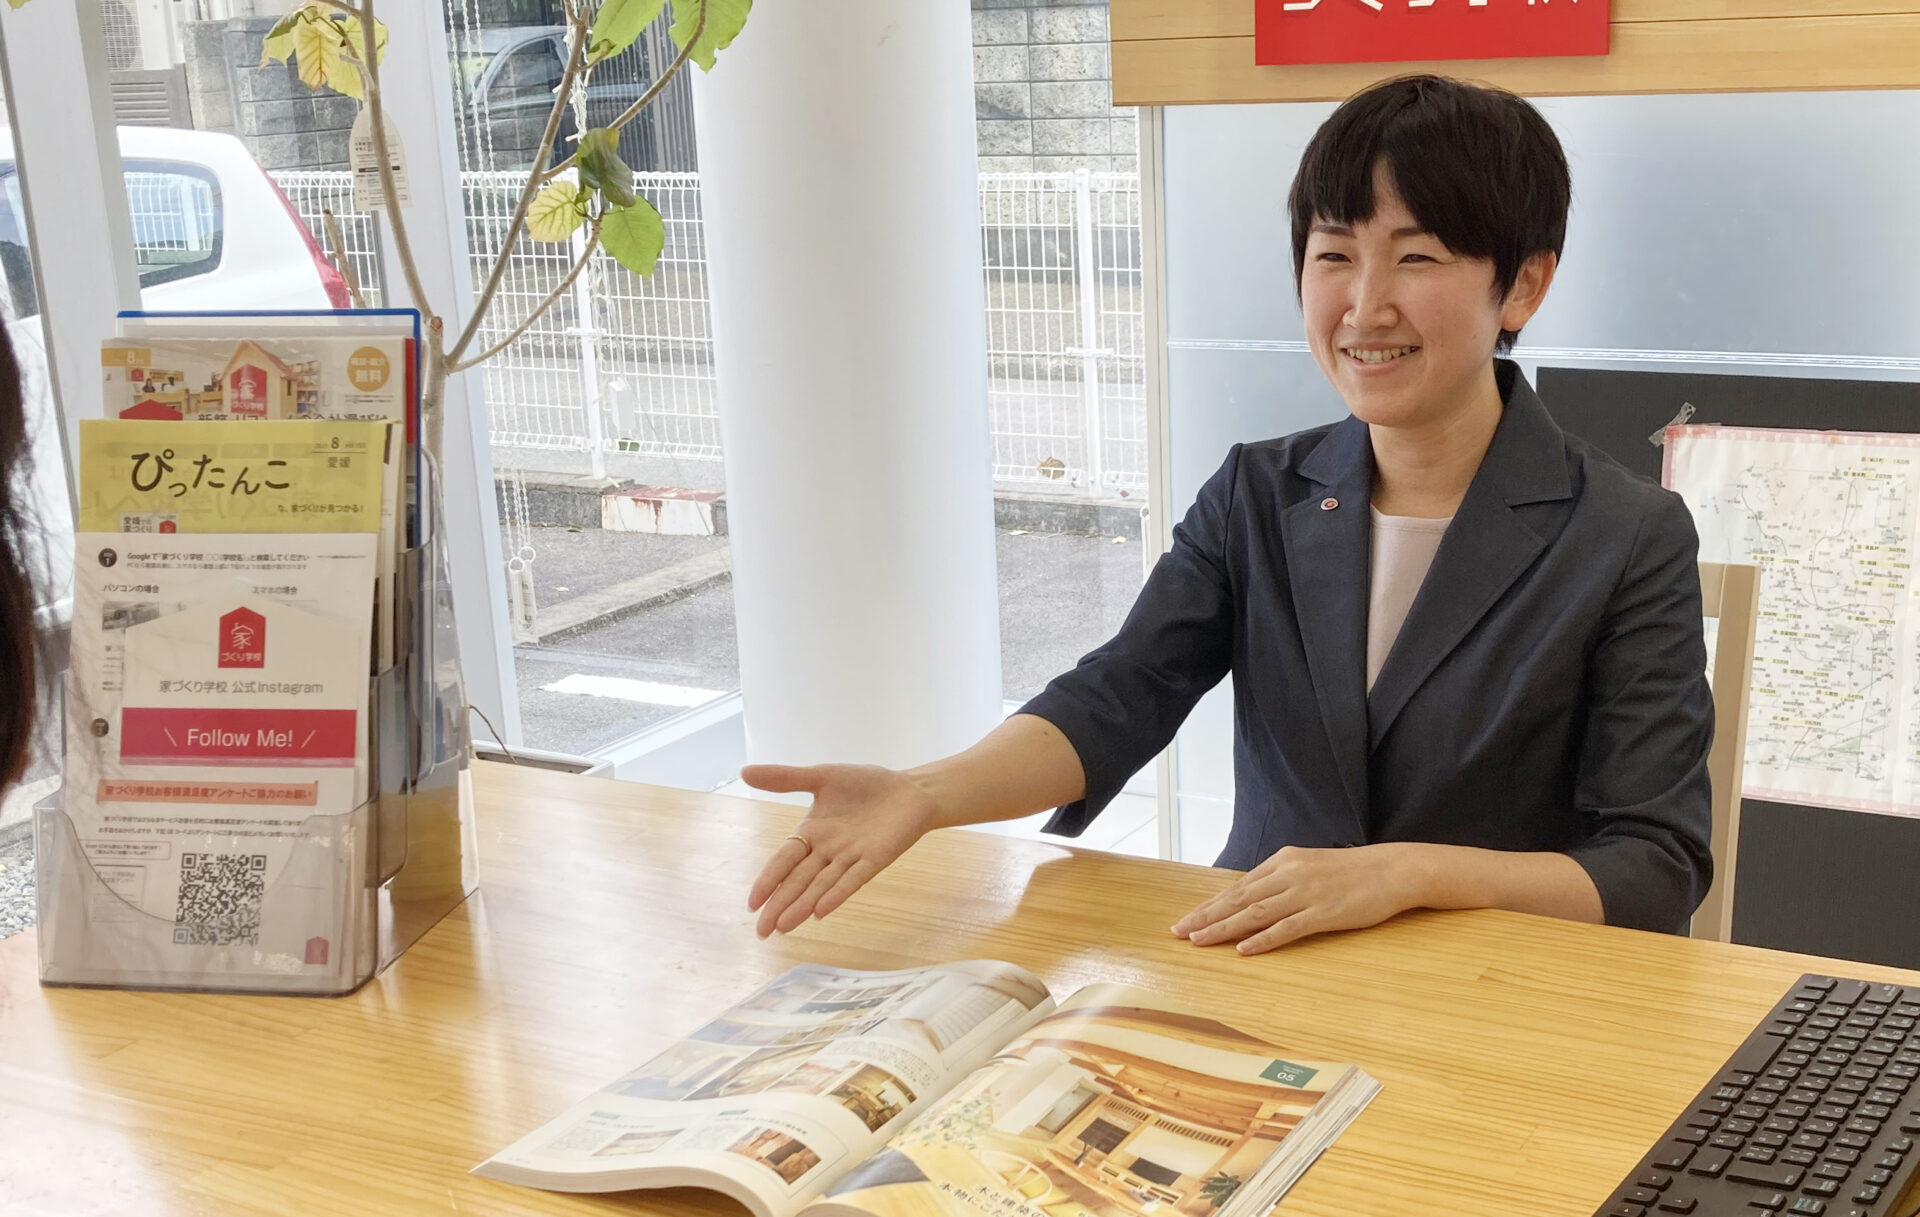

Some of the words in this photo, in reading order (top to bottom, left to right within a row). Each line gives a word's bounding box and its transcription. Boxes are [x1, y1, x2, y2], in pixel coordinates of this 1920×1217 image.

[331, 437, 340, 449] 8
[328, 456, 351, 468] 愛媛
[131, 449, 290, 498] ぴったんこ
[103, 584, 159, 594] パソコンの場合
[252, 586, 298, 595] スマホの場合
[220, 652, 262, 662] づくり学校
[160, 681, 228, 694] 家づくり学校
[187, 729, 250, 747] Follow
[257, 730, 293, 747] Me!
[1277, 1072, 1296, 1081] 05
